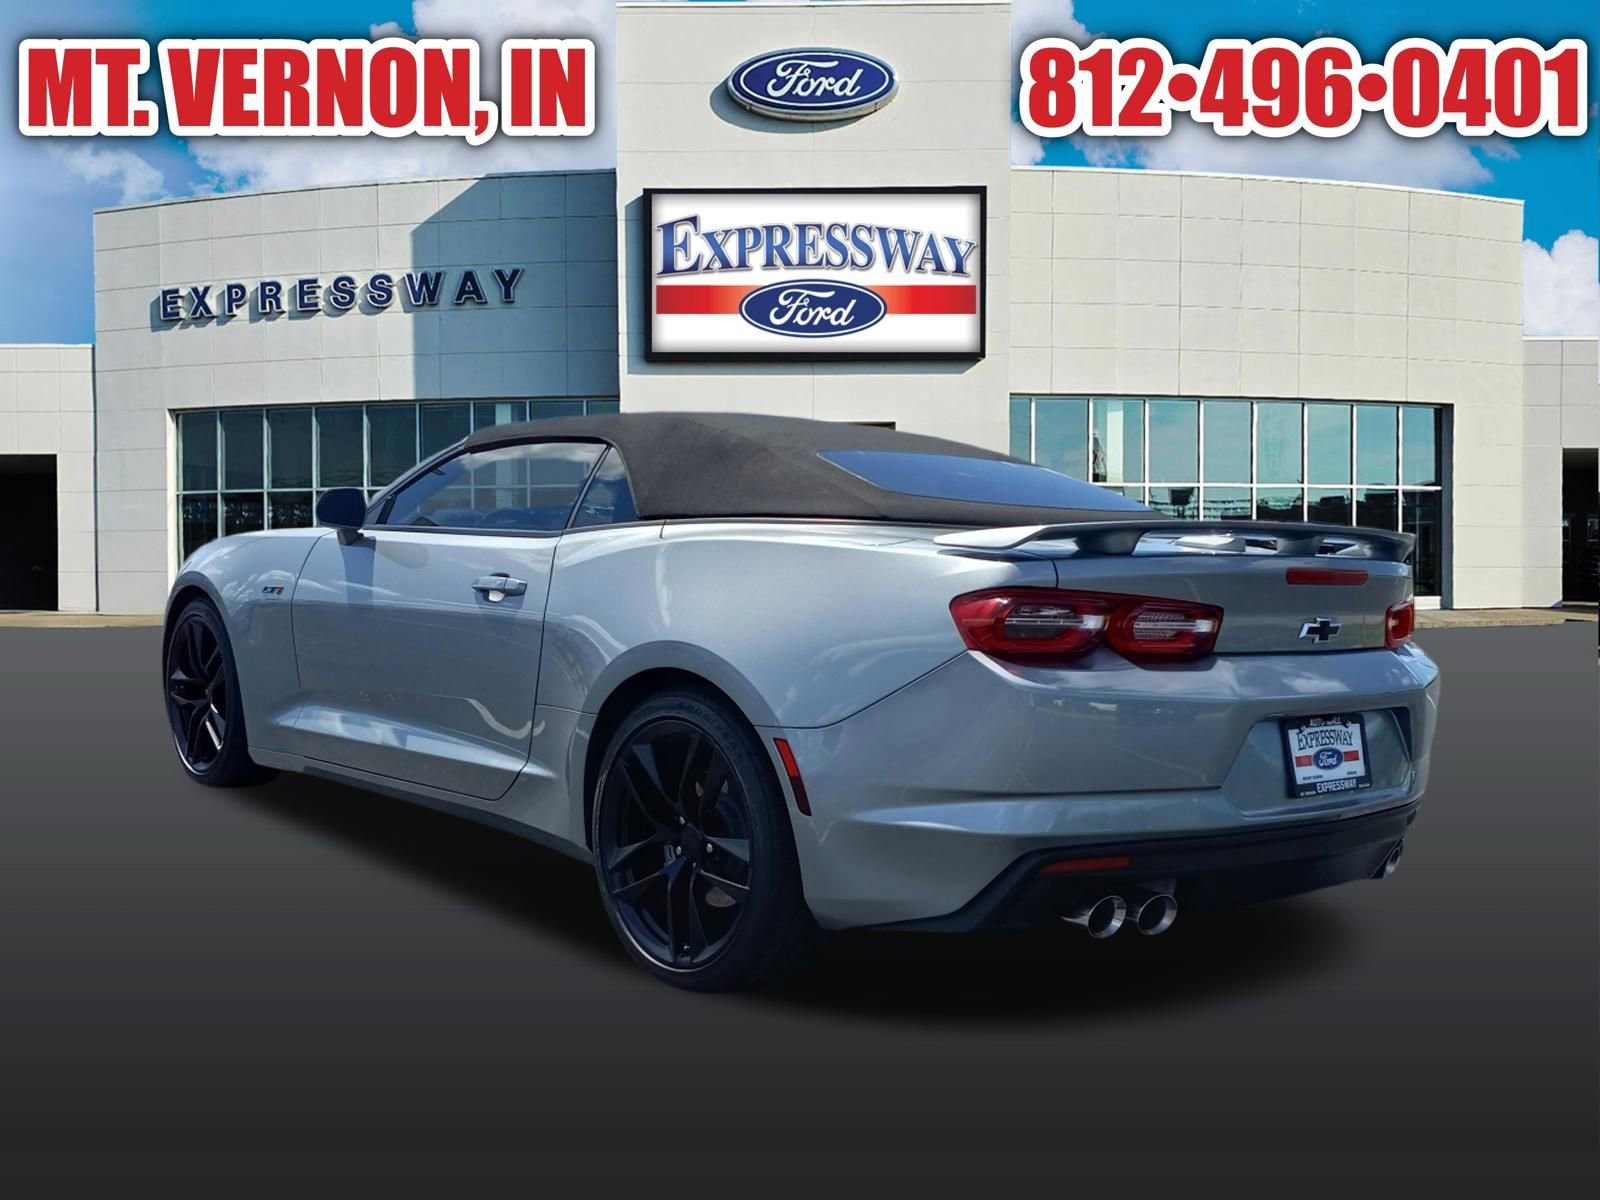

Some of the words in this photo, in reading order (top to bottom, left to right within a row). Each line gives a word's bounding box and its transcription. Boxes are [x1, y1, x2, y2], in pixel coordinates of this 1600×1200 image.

[766, 59, 864, 98] Ford
[656, 214, 978, 278] EXPRESSWAY
[159, 267, 526, 323] EXPRESSWAY
[768, 288, 857, 327] Ford
[1296, 729, 1353, 750] EXPRESSWAY
[1318, 751, 1338, 766] Ford
[1316, 778, 1357, 793] EXPRESSWAY
